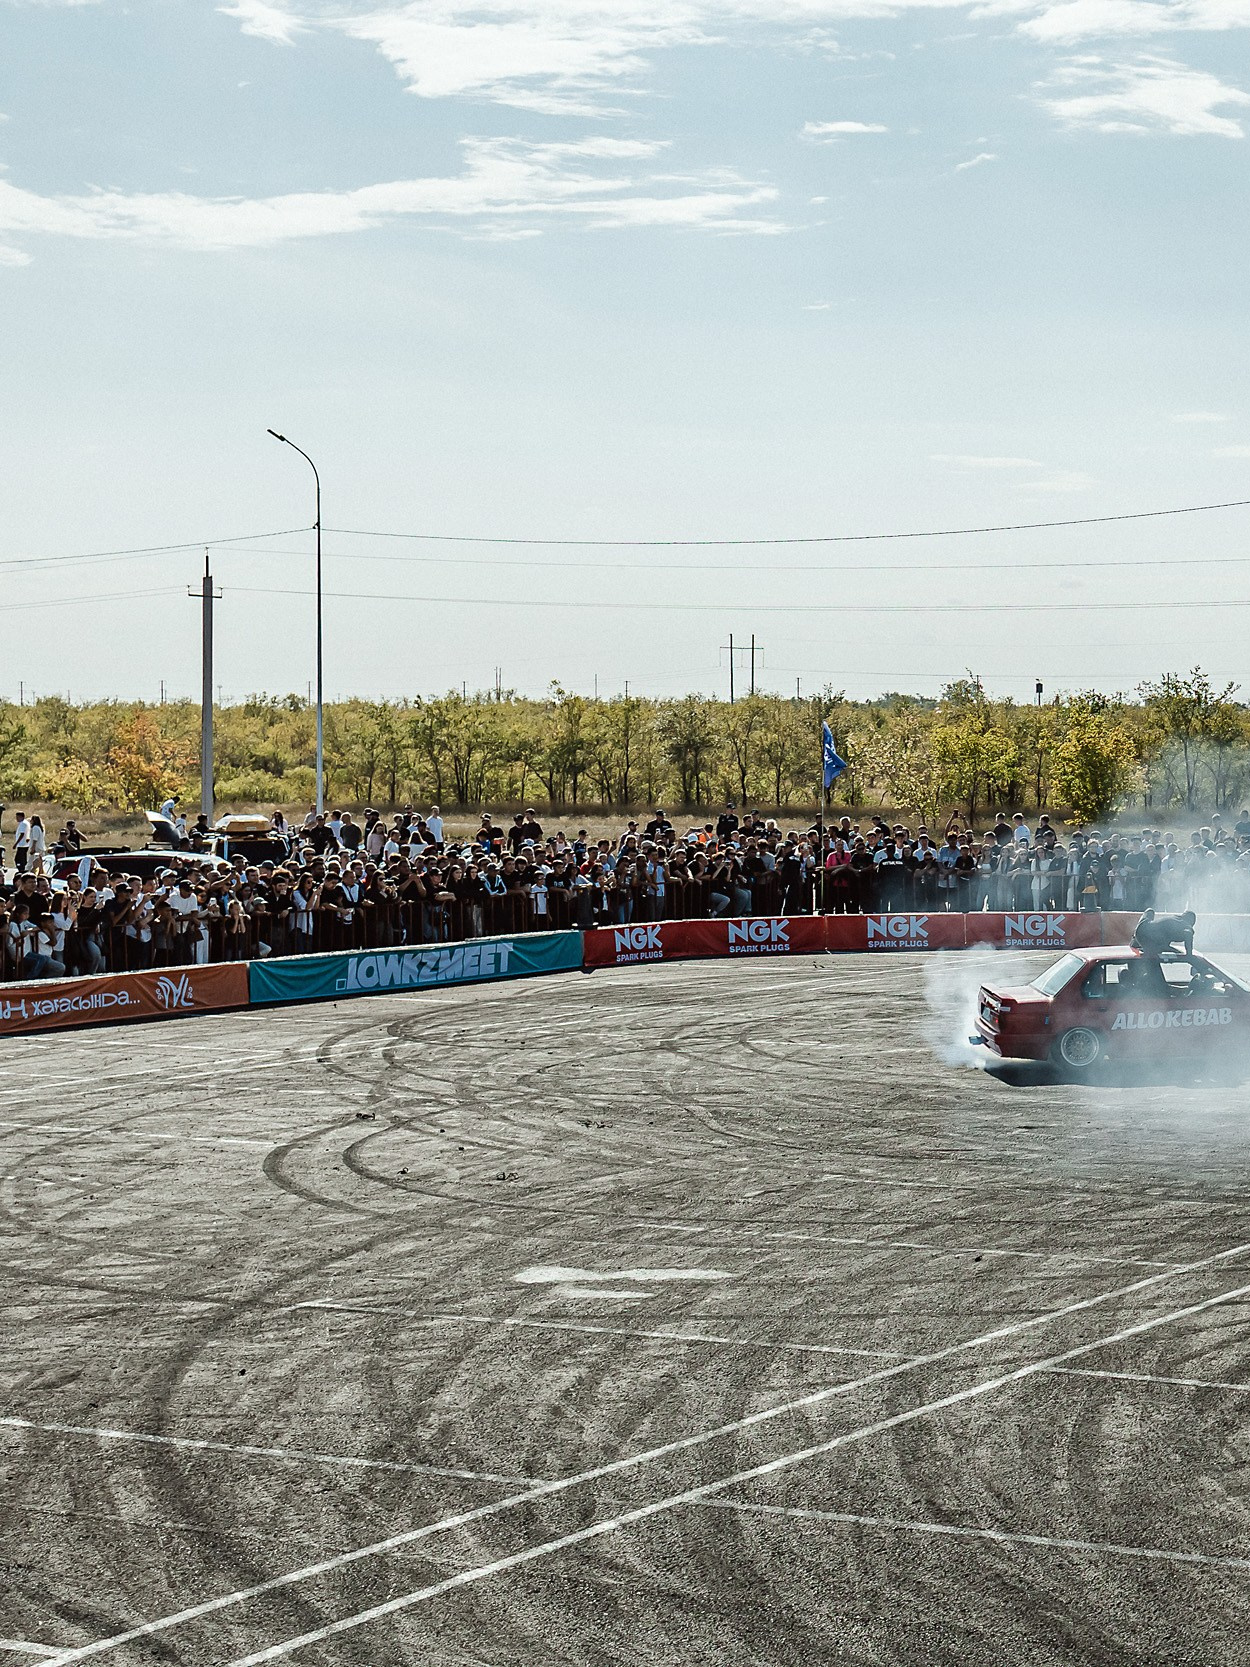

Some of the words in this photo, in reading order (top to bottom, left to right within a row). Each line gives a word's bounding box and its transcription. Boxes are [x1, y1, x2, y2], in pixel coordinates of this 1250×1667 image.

[728, 919, 790, 943] NGK
[867, 915, 929, 938] NGK
[1005, 914, 1066, 937] NGK
[614, 924, 663, 952] NGK
[729, 945, 759, 953] SPARK
[760, 943, 790, 952] PLUGS
[868, 940, 897, 948] SPARK
[899, 939, 929, 947] PLUGS
[1005, 938, 1035, 946] SPARK
[1036, 938, 1066, 946] PLUGS
[346, 942, 514, 990] LOWKZMEET
[616, 952, 639, 962] SPARK
[640, 950, 663, 960] PLUGS
